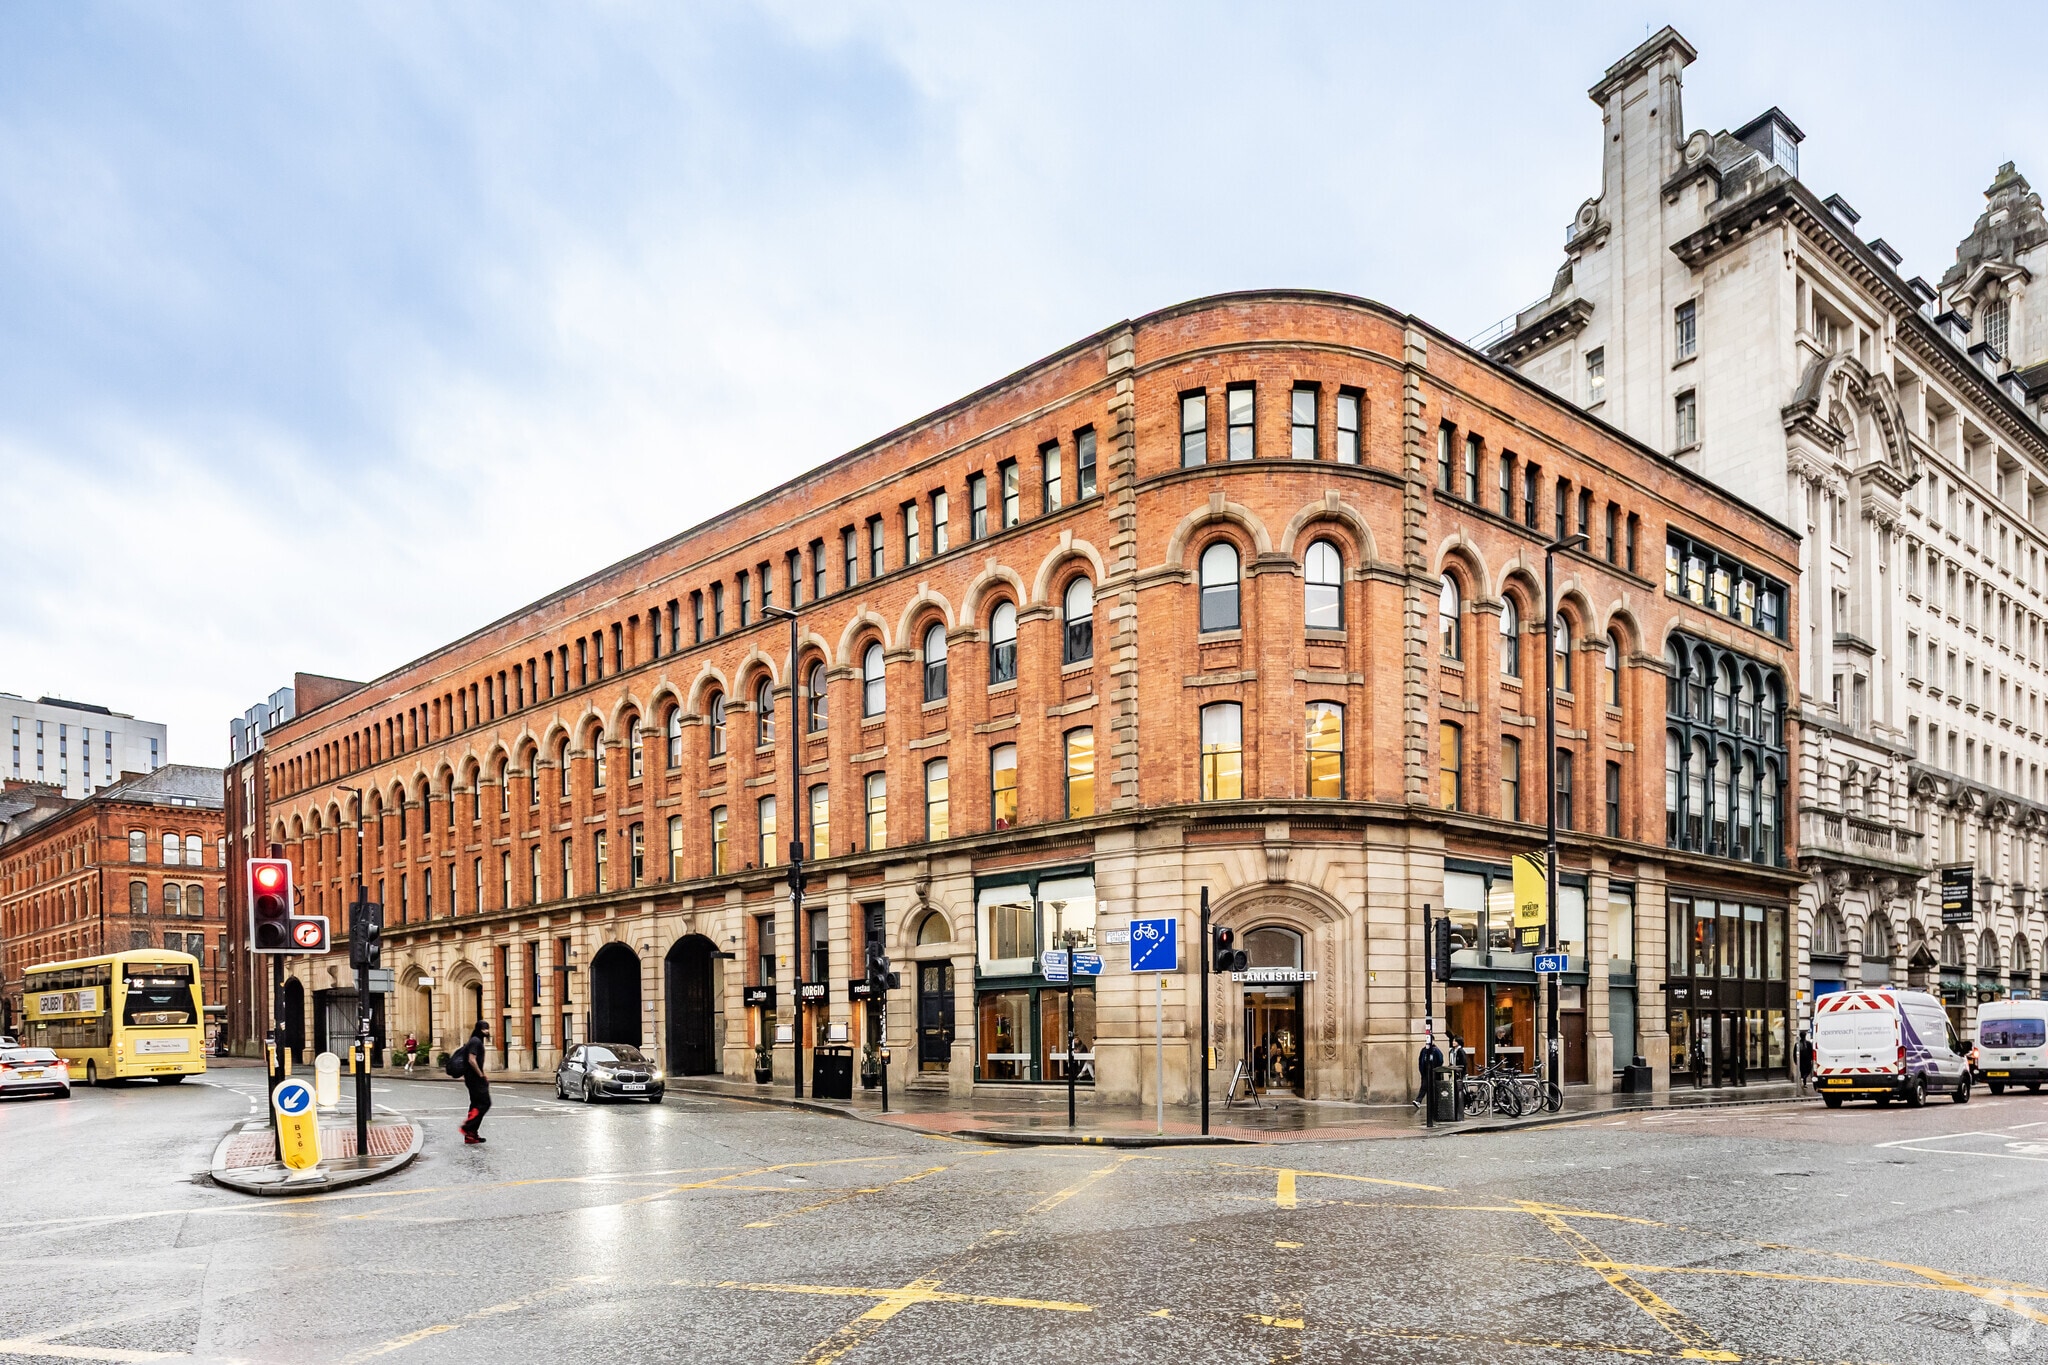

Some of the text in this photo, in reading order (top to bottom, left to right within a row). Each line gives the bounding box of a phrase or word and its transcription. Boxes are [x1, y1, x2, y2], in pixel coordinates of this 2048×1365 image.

[1231, 971, 1318, 981] BLANK STREET
[802, 984, 825, 997] IORGIO
[854, 985, 870, 993] restau
[752, 990, 767, 998] italian
[40, 996, 62, 1011] GRUBBY
[1820, 1028, 1854, 1036] openreach
